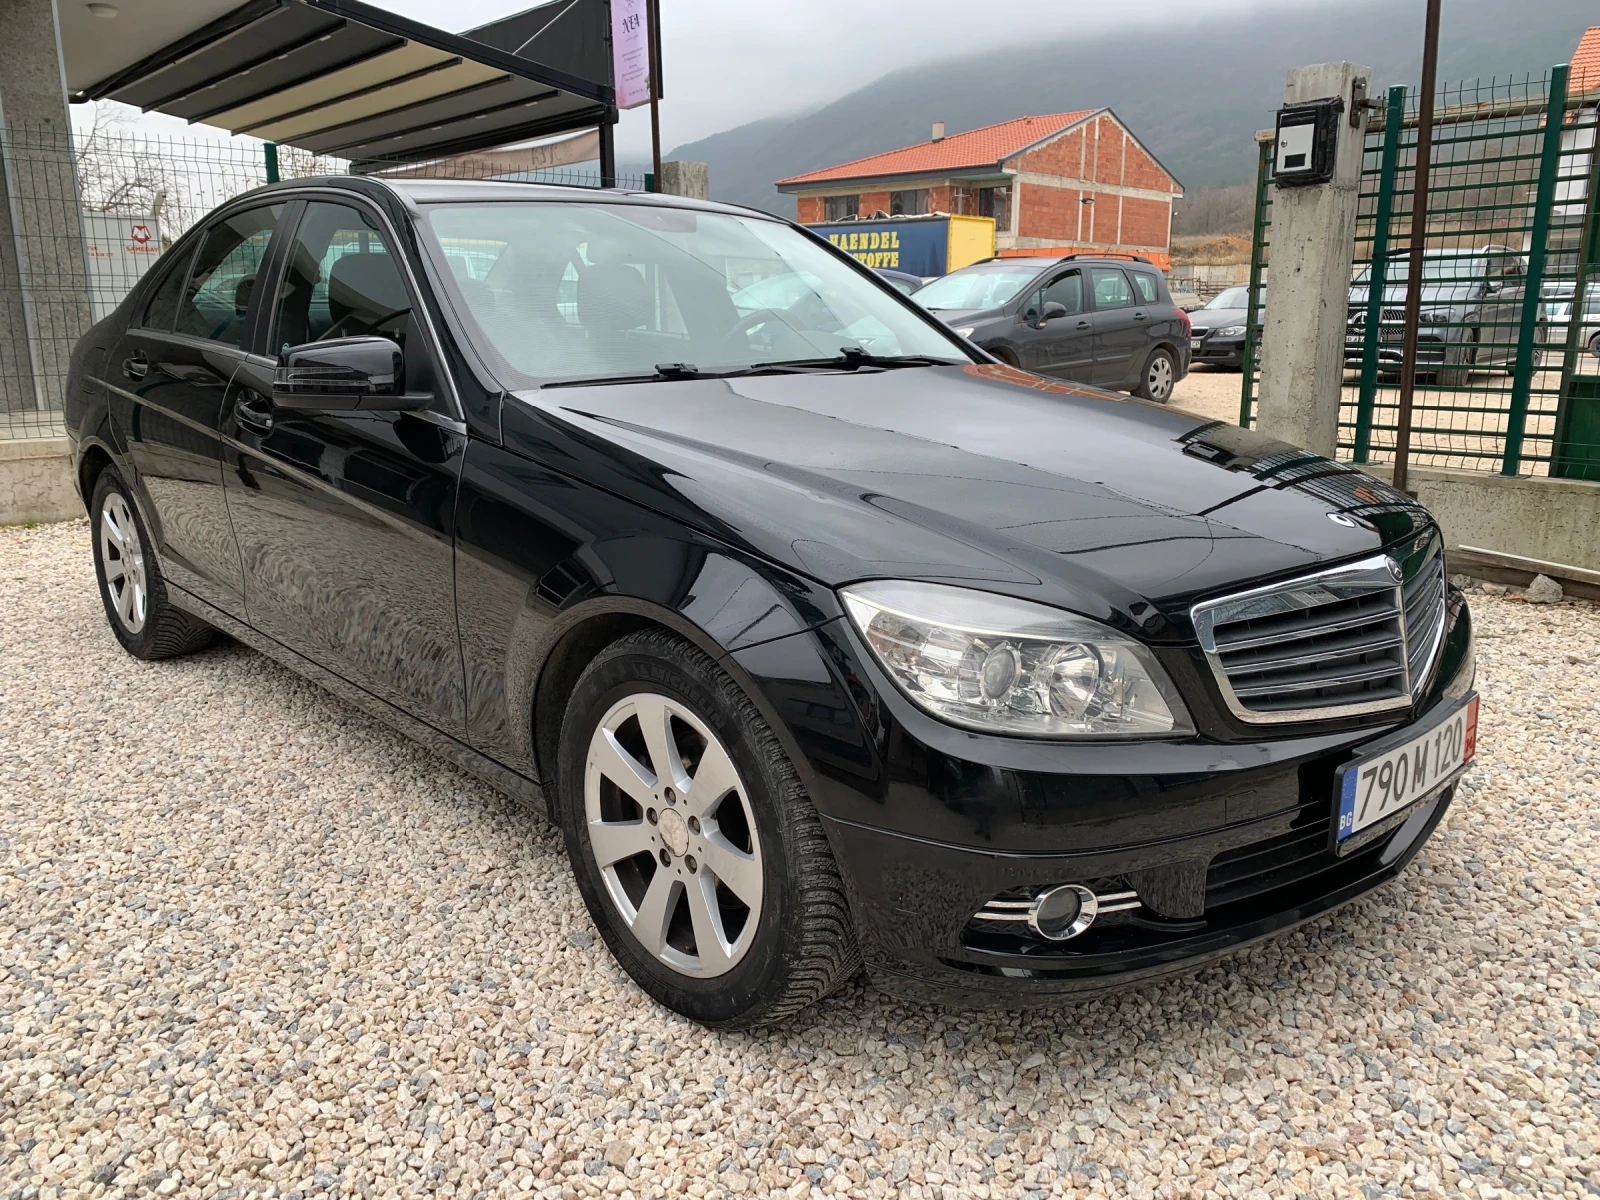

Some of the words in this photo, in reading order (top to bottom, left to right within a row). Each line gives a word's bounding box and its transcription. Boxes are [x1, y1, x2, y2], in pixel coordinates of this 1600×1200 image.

[650, 665, 726, 730] MICHELIN
[1358, 752, 1409, 822] 790
[1411, 740, 1429, 793] M
[1434, 716, 1463, 778] 120
[1339, 811, 1353, 831] BG
